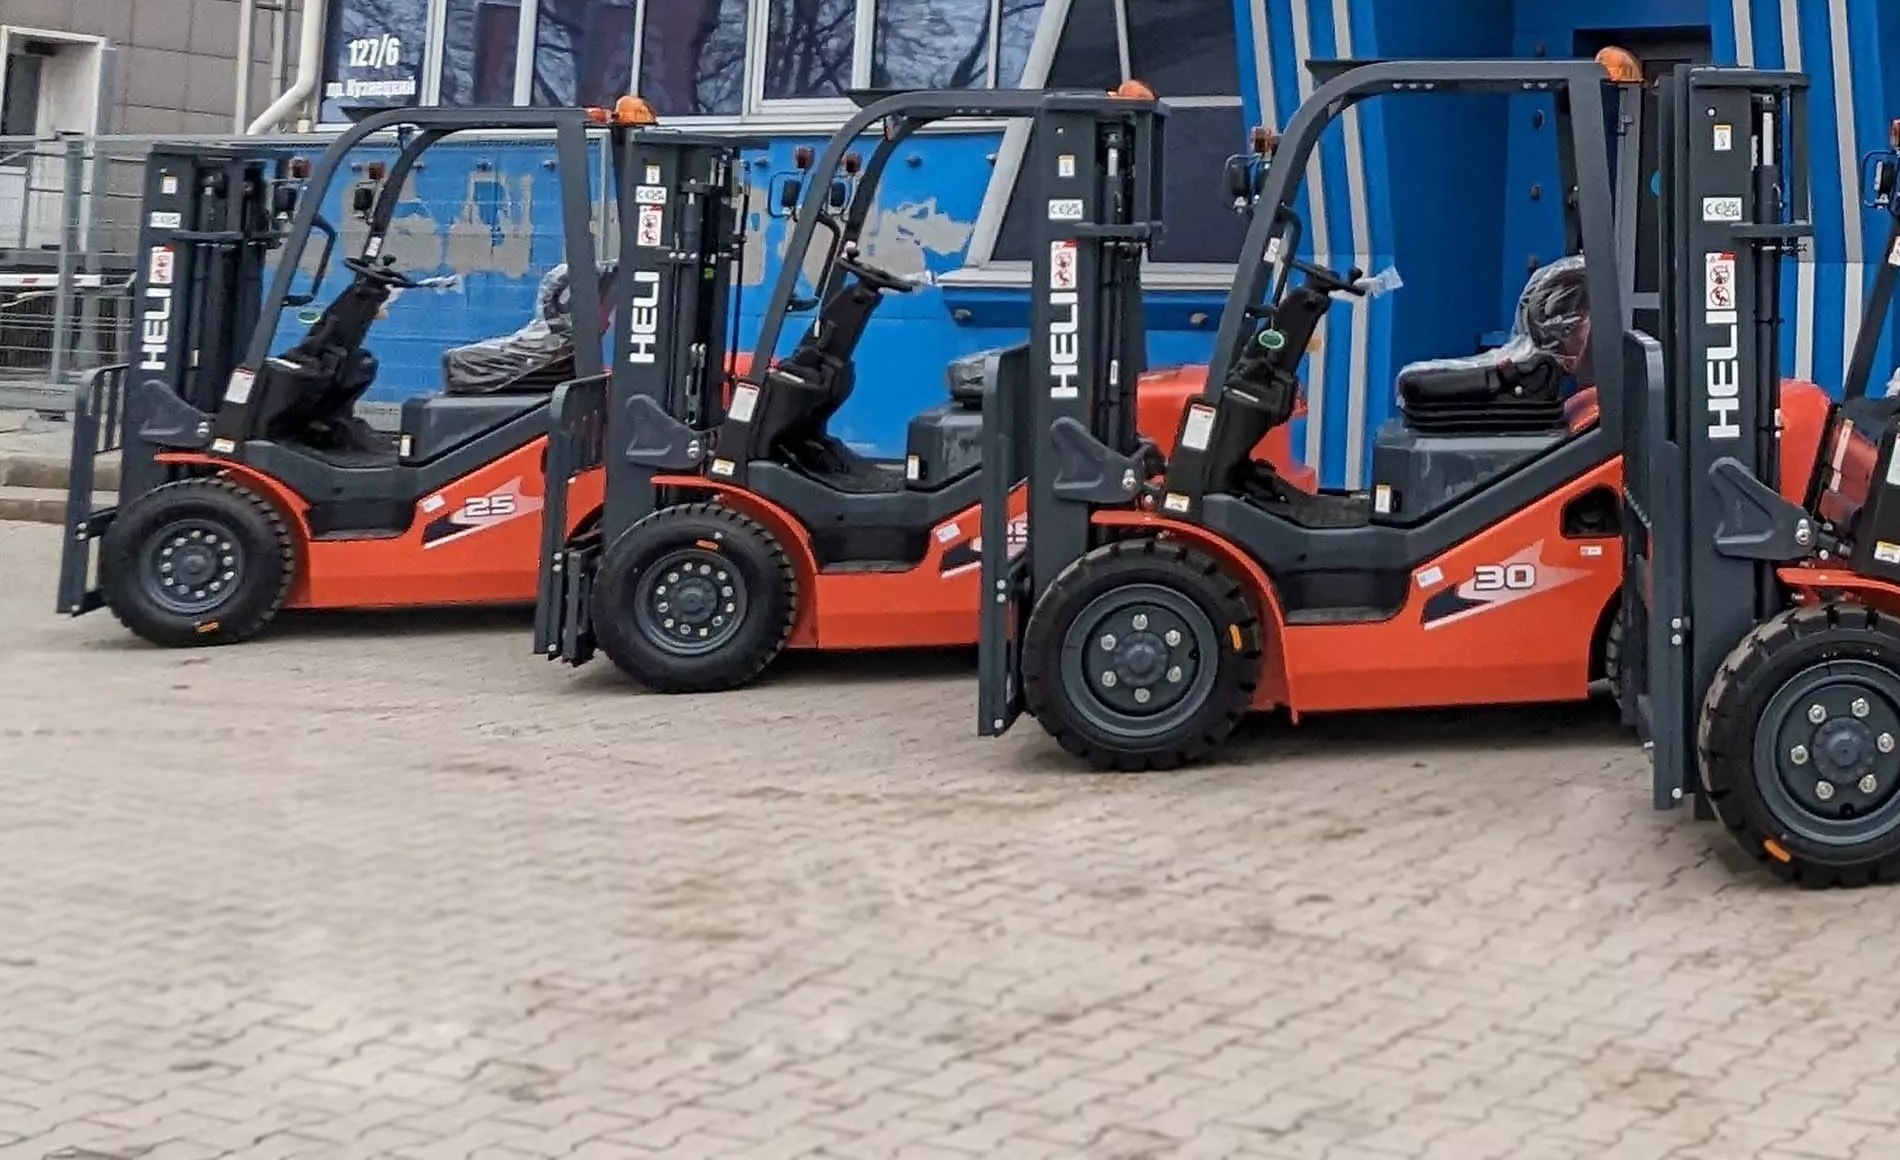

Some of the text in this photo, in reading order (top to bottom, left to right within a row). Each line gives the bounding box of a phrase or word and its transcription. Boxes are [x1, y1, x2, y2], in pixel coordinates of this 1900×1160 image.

[347, 33, 400, 69] 127/6
[140, 287, 172, 370] HELI
[630, 271, 660, 363] HELI
[1050, 292, 1078, 398] HELI
[1706, 310, 1740, 439] HELI
[465, 494, 516, 517] 25
[1475, 563, 1536, 591] 30
